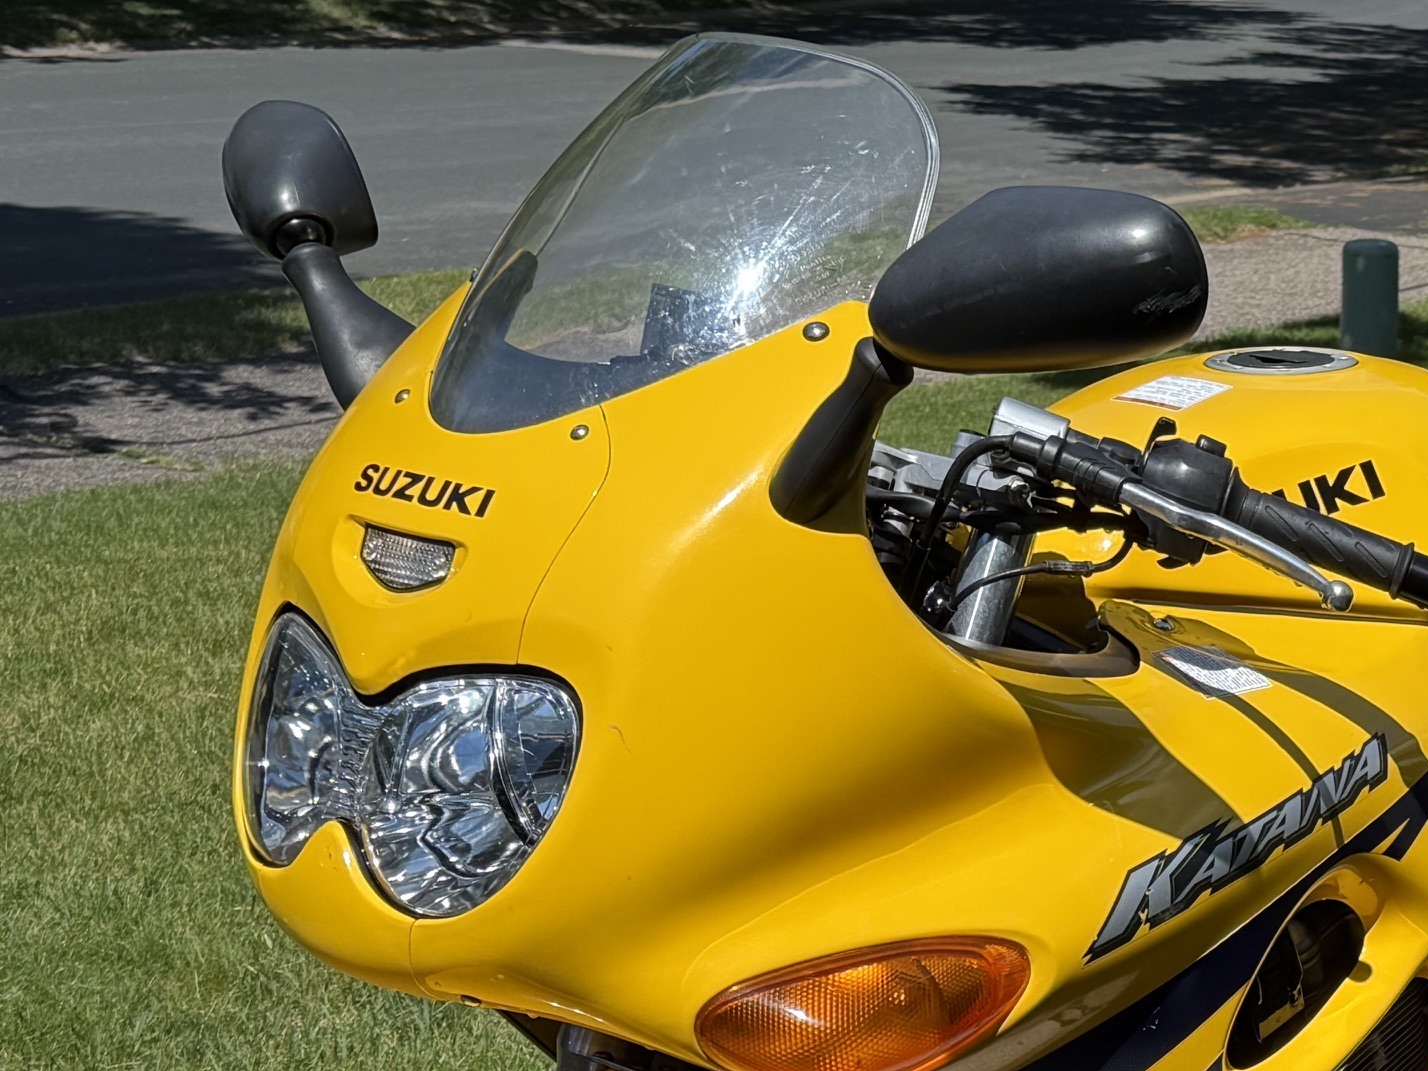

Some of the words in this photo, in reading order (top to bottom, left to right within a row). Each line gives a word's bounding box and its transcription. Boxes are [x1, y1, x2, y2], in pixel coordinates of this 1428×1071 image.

[354, 463, 496, 517] SUZUKI
[1270, 459, 1386, 515] UKI
[1083, 732, 1388, 966] KATANA
